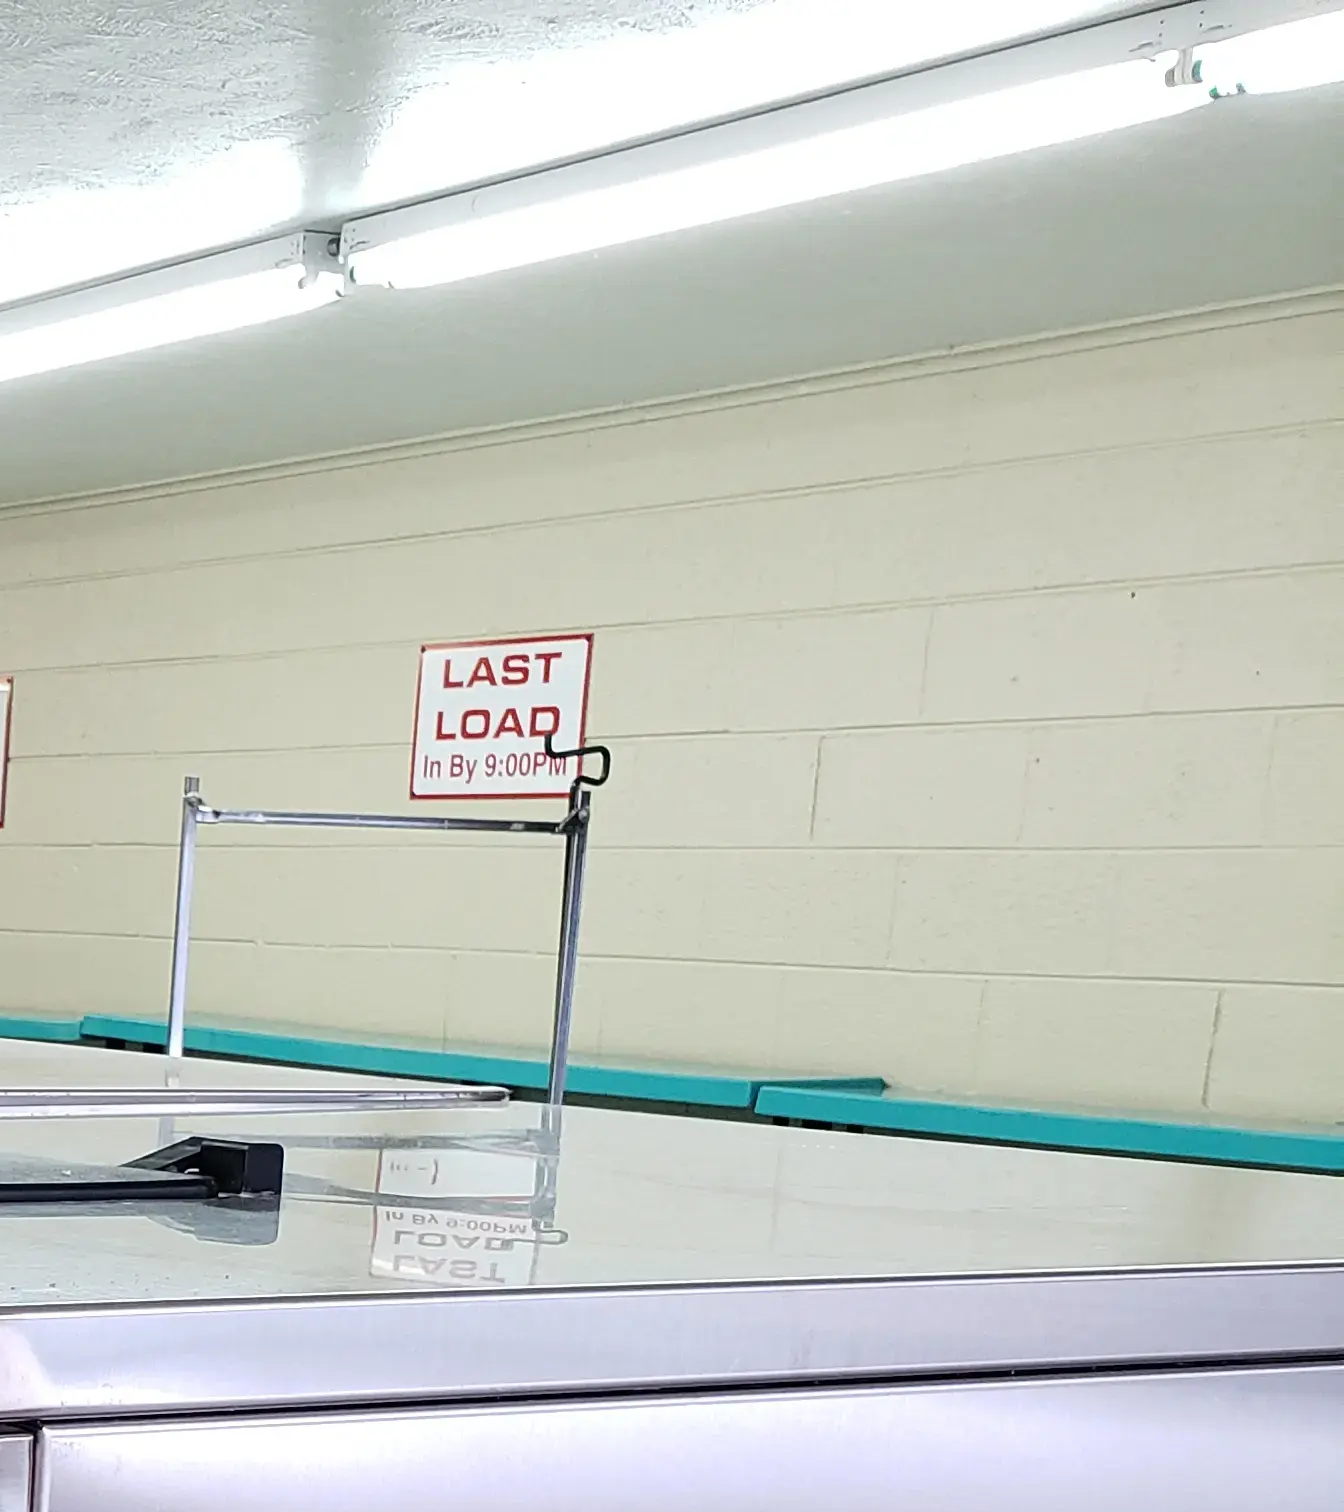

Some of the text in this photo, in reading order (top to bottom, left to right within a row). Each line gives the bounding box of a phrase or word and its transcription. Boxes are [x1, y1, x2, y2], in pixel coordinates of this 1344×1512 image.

[443, 652, 563, 689] LAST
[435, 706, 561, 740] LOAD
[422, 752, 568, 784] In By 9:00PM
